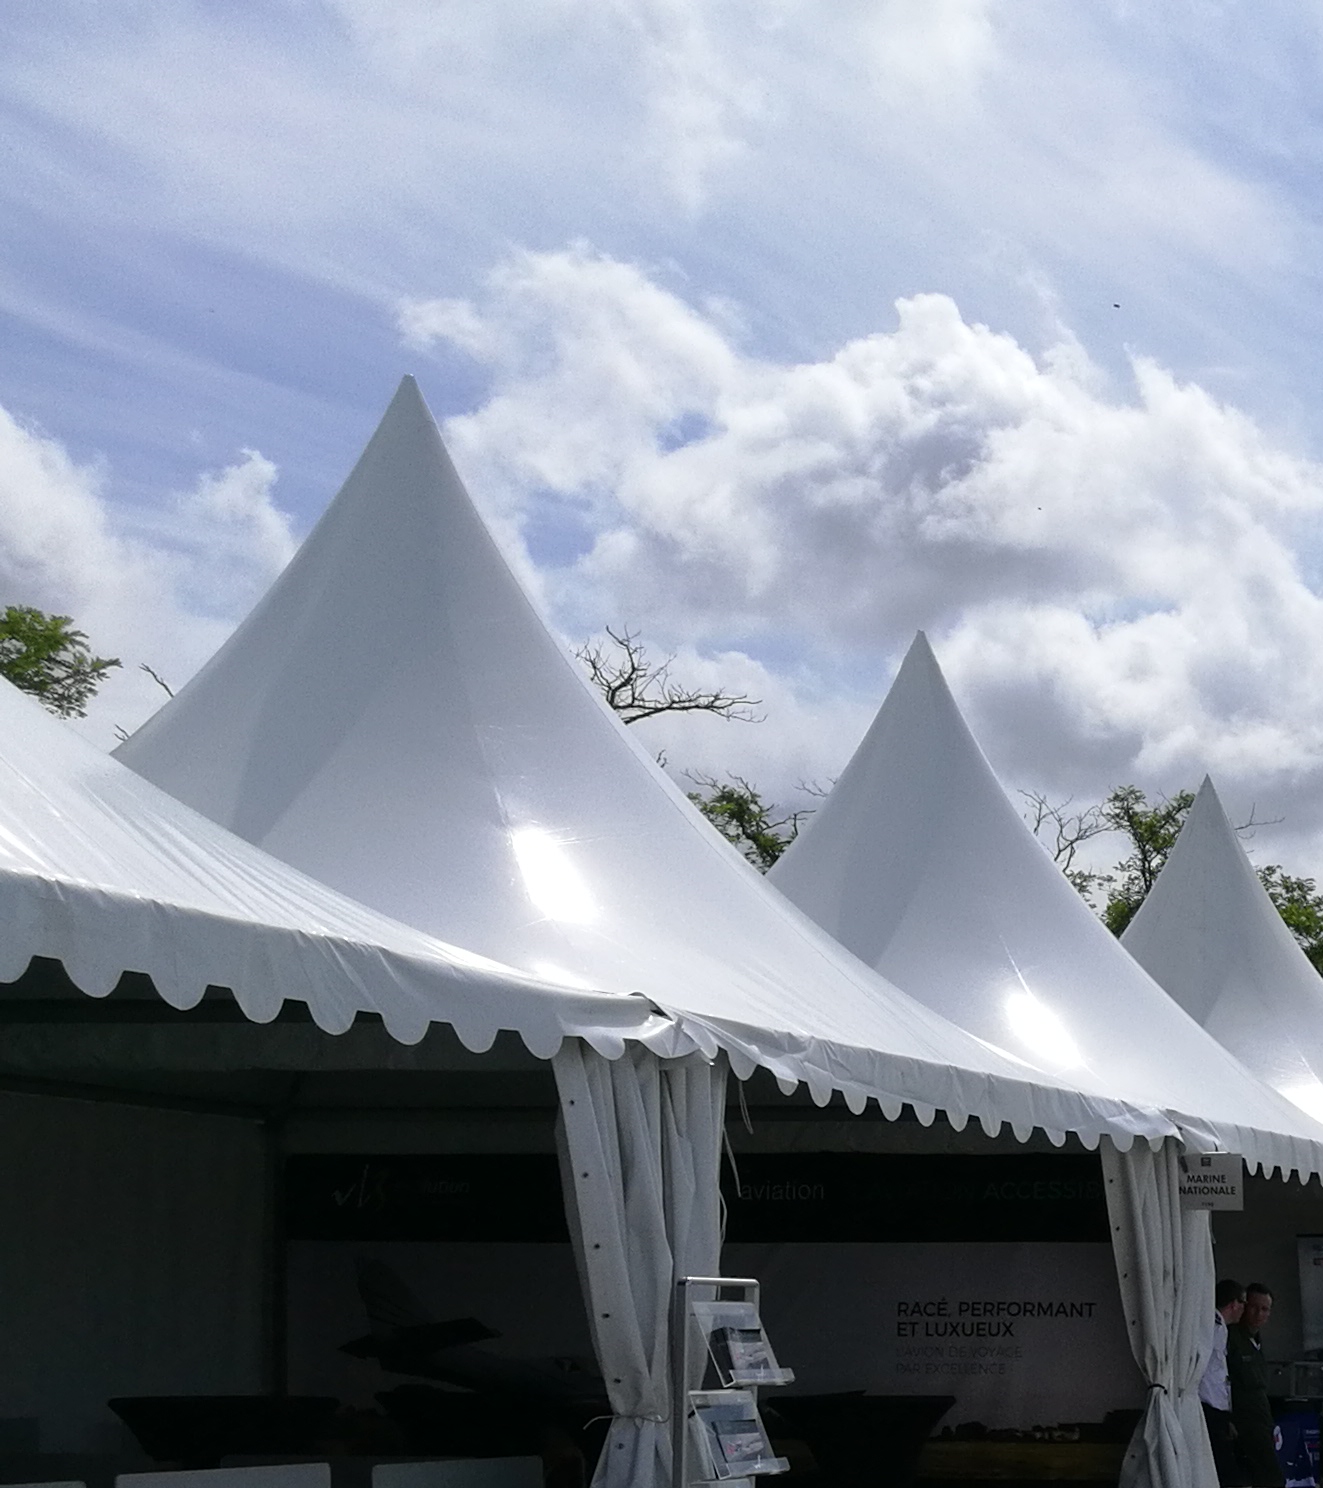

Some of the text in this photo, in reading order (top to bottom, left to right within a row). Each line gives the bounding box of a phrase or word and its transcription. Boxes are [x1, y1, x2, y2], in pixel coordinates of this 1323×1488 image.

[1187, 1174, 1227, 1184] MARINE
[1179, 1186, 1236, 1196] NATIONALE
[897, 1298, 1097, 1318] RACÉ, PERFORMANT
[897, 1322, 1014, 1337] ET LUXUEUX
[971, 1346, 1023, 1358] VOYAGE
